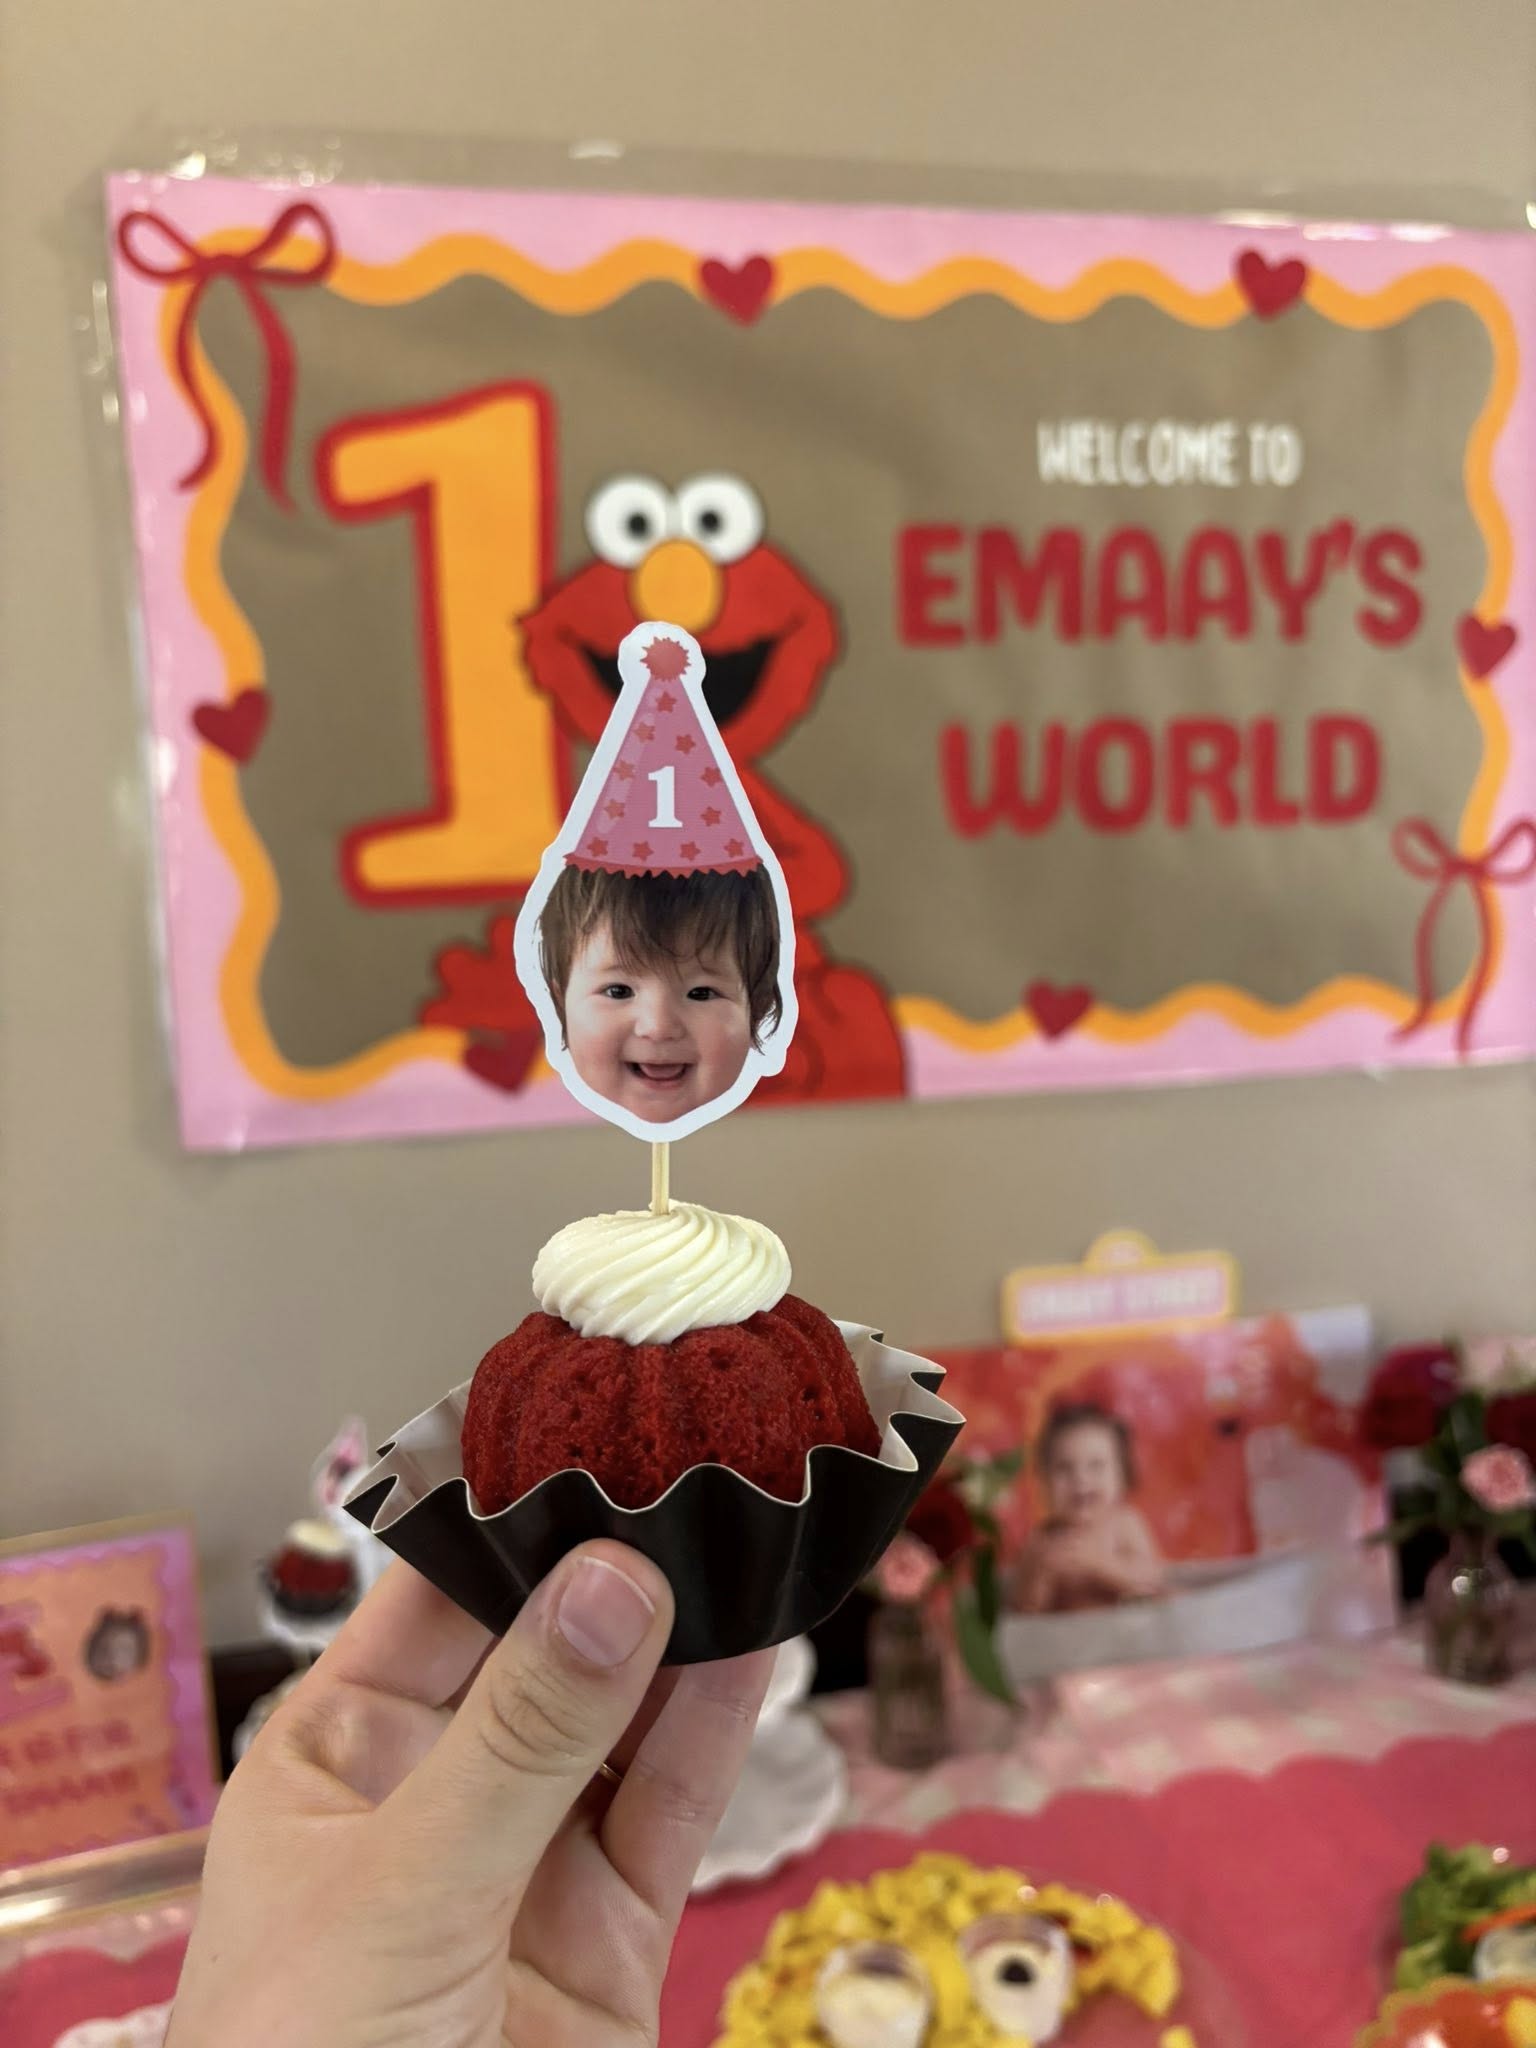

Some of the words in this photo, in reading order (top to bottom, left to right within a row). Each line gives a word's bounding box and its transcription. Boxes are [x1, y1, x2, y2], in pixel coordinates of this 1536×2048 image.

[1037, 420, 1238, 486] WELCOME
[1249, 422, 1303, 486] TO
[315, 380, 572, 911] 1
[897, 518, 1424, 649] EMAAY'S
[648, 766, 683, 828] 1
[939, 713, 1382, 840] WORLD
